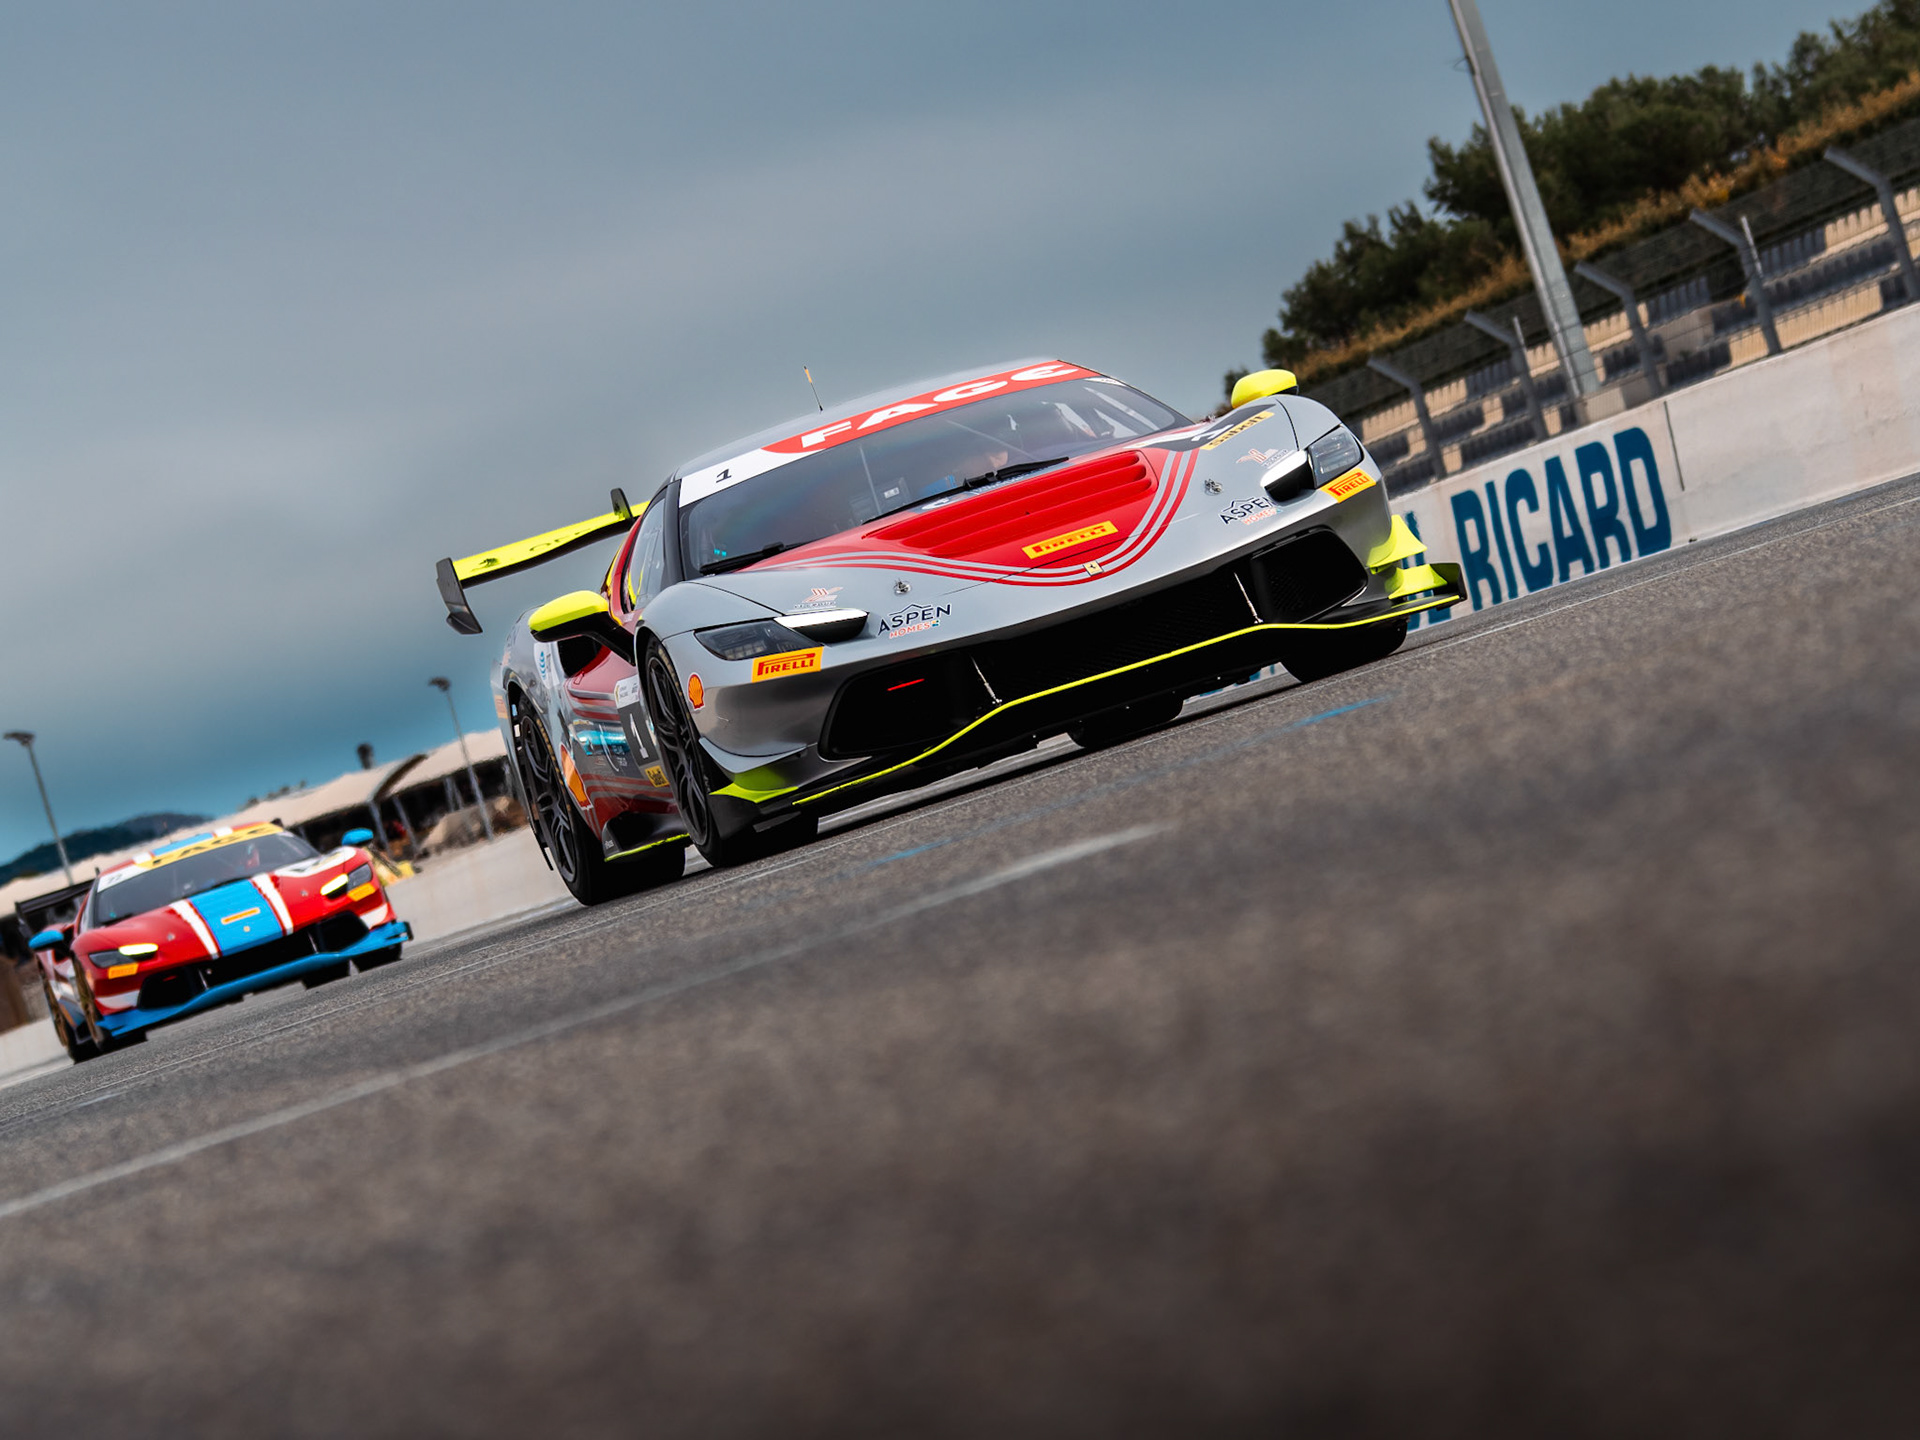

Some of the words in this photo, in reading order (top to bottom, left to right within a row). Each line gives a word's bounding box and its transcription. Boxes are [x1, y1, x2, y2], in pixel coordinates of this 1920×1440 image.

[801, 364, 1079, 448] FAGE
[716, 468, 732, 483] 1
[1328, 472, 1370, 496] PIRELLI
[1451, 427, 1672, 611] RICARD
[1032, 525, 1107, 553] PIRELLI
[877, 604, 951, 636] ASPEN
[889, 622, 930, 639] HOMES
[757, 653, 816, 676] PIRELLI
[630, 713, 649, 759] 1
